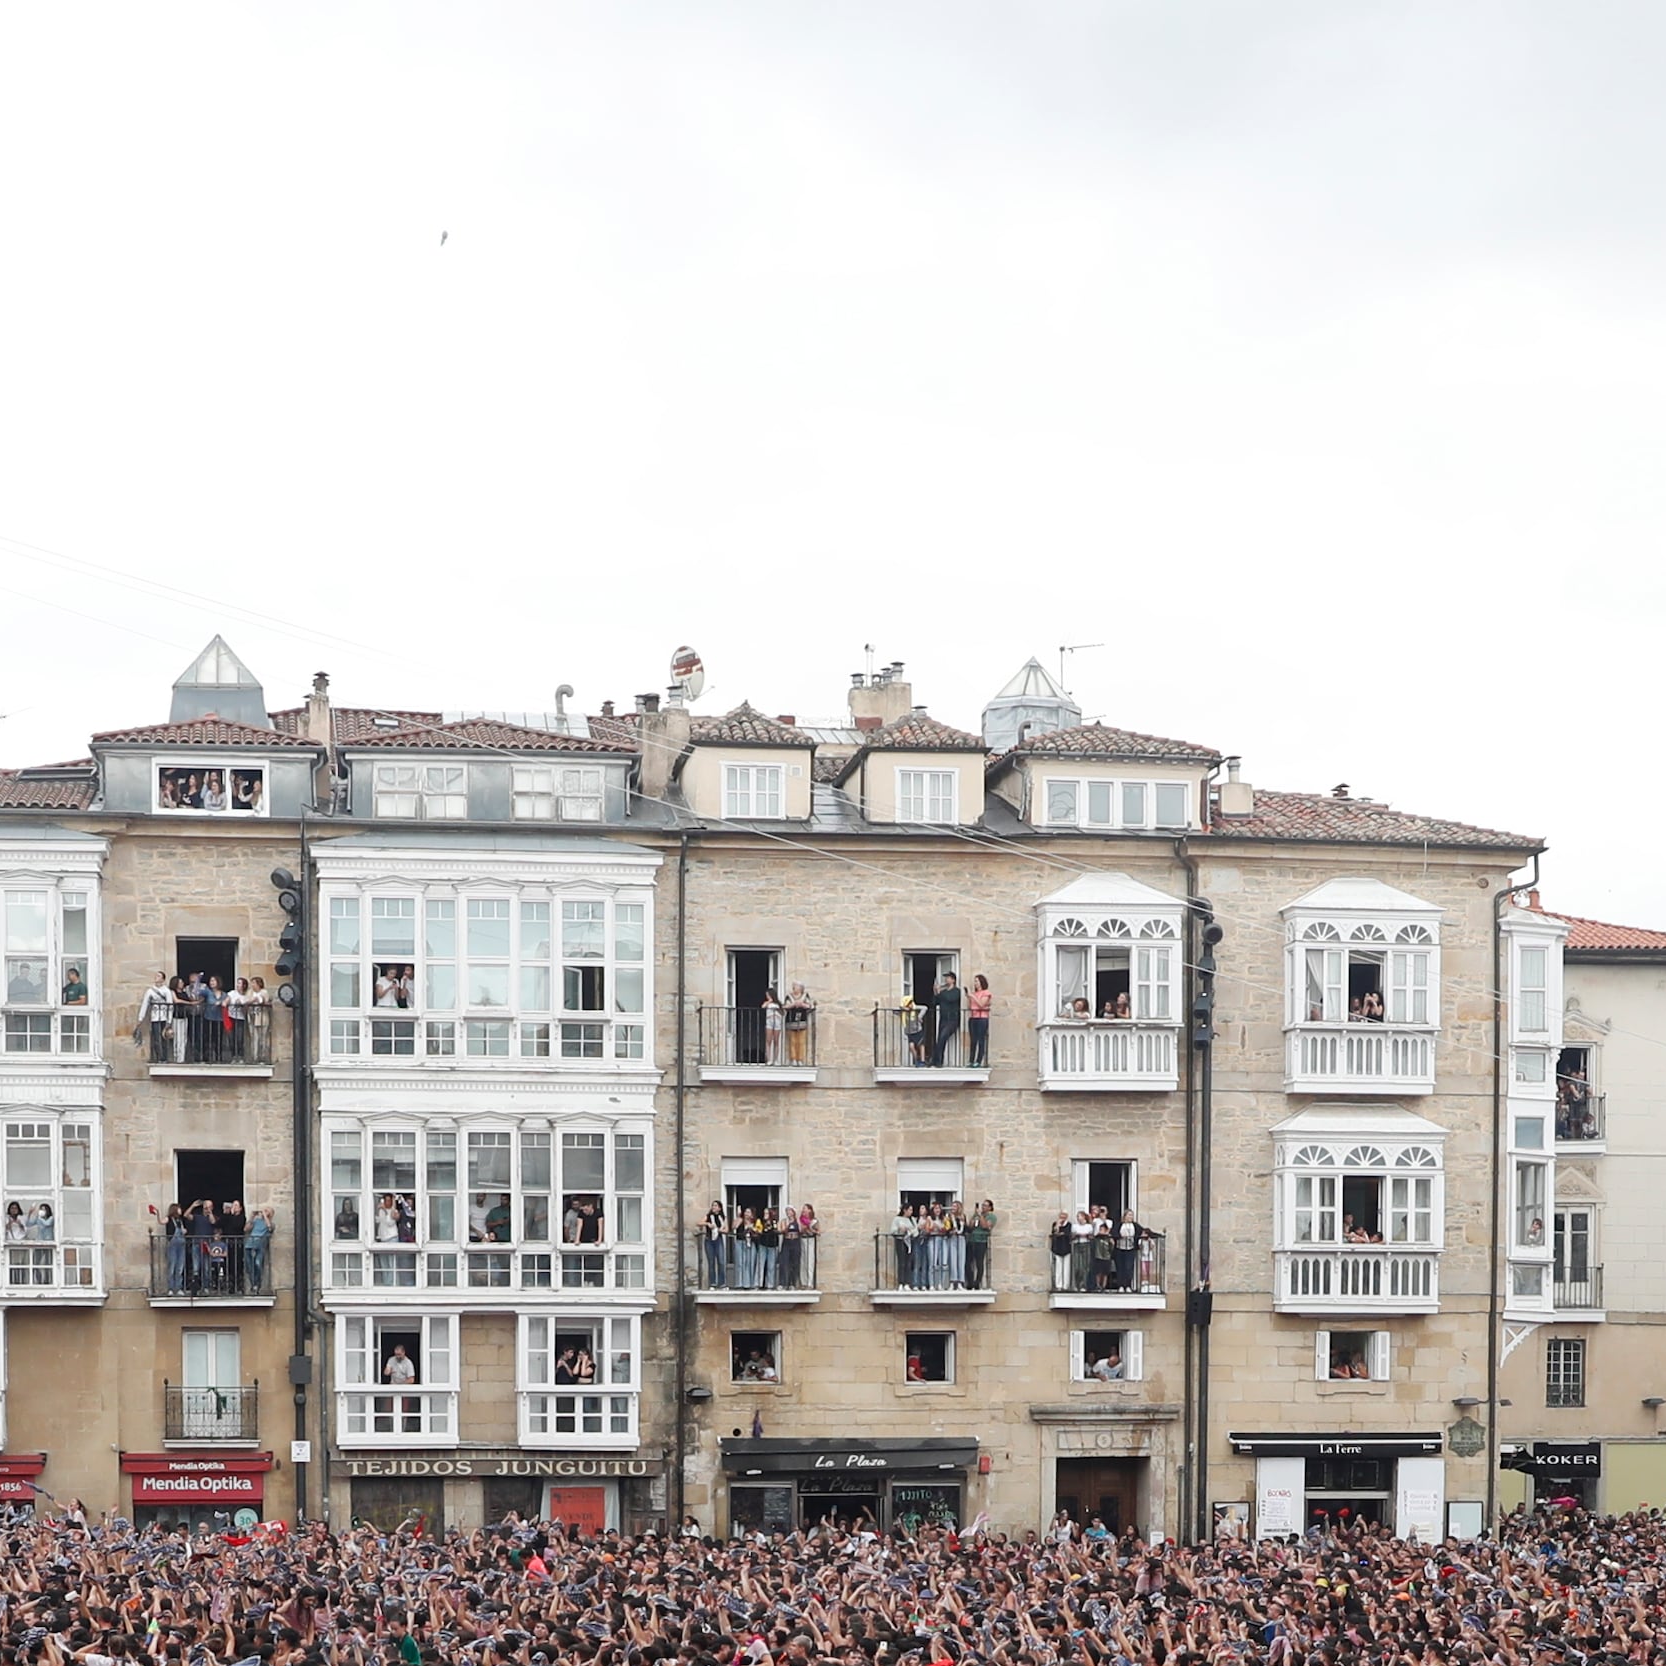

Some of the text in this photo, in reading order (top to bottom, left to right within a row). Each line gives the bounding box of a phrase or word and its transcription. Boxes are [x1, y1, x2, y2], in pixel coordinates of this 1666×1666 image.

[815, 1454, 887, 1468] La Plaza
[1536, 1455, 1598, 1465] KOKER
[169, 1462, 225, 1472] Mendia Optika
[347, 1460, 648, 1476] TEJIDOS JUNGUITU
[0, 1480, 22, 1492] 1856
[142, 1476, 253, 1493] Mendia Optika
